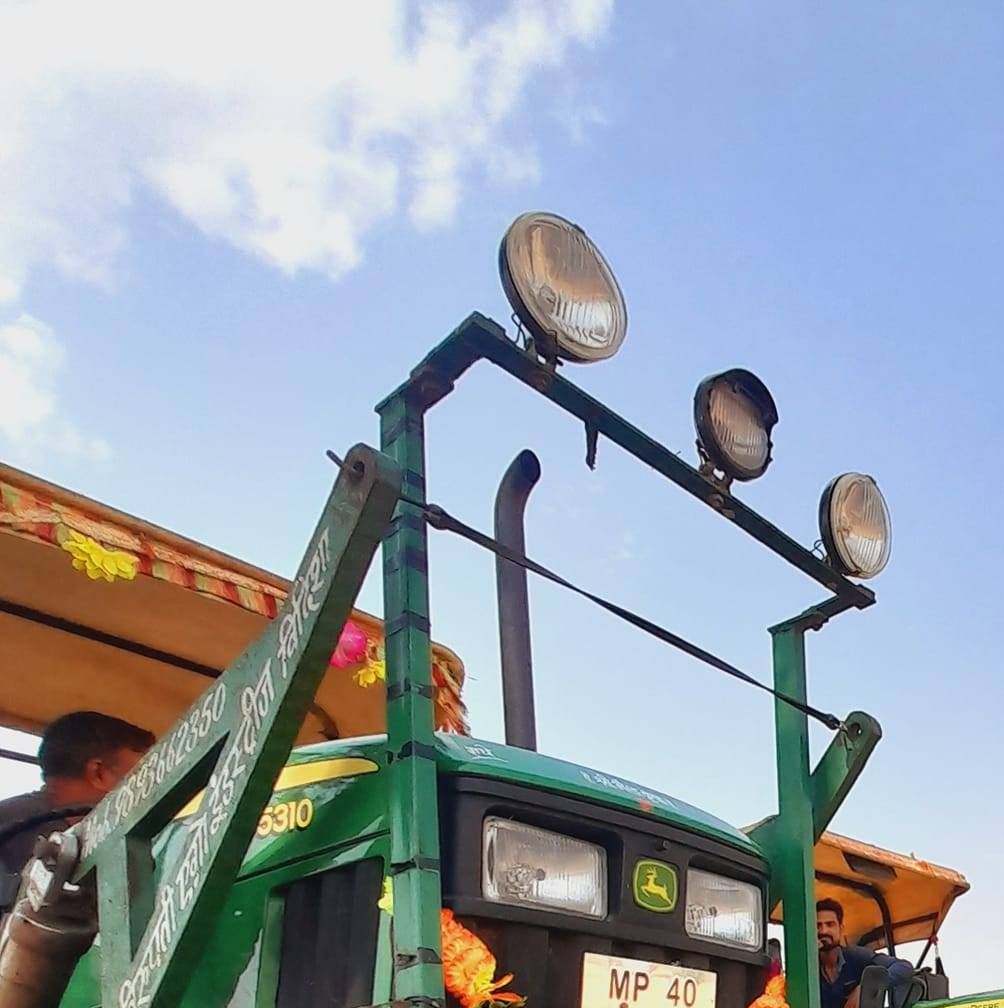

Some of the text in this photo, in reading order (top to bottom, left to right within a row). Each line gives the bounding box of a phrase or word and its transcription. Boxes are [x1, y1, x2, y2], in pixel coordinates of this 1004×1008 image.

[256, 798, 314, 836] 5310
[608, 968, 697, 1008] MP 40
